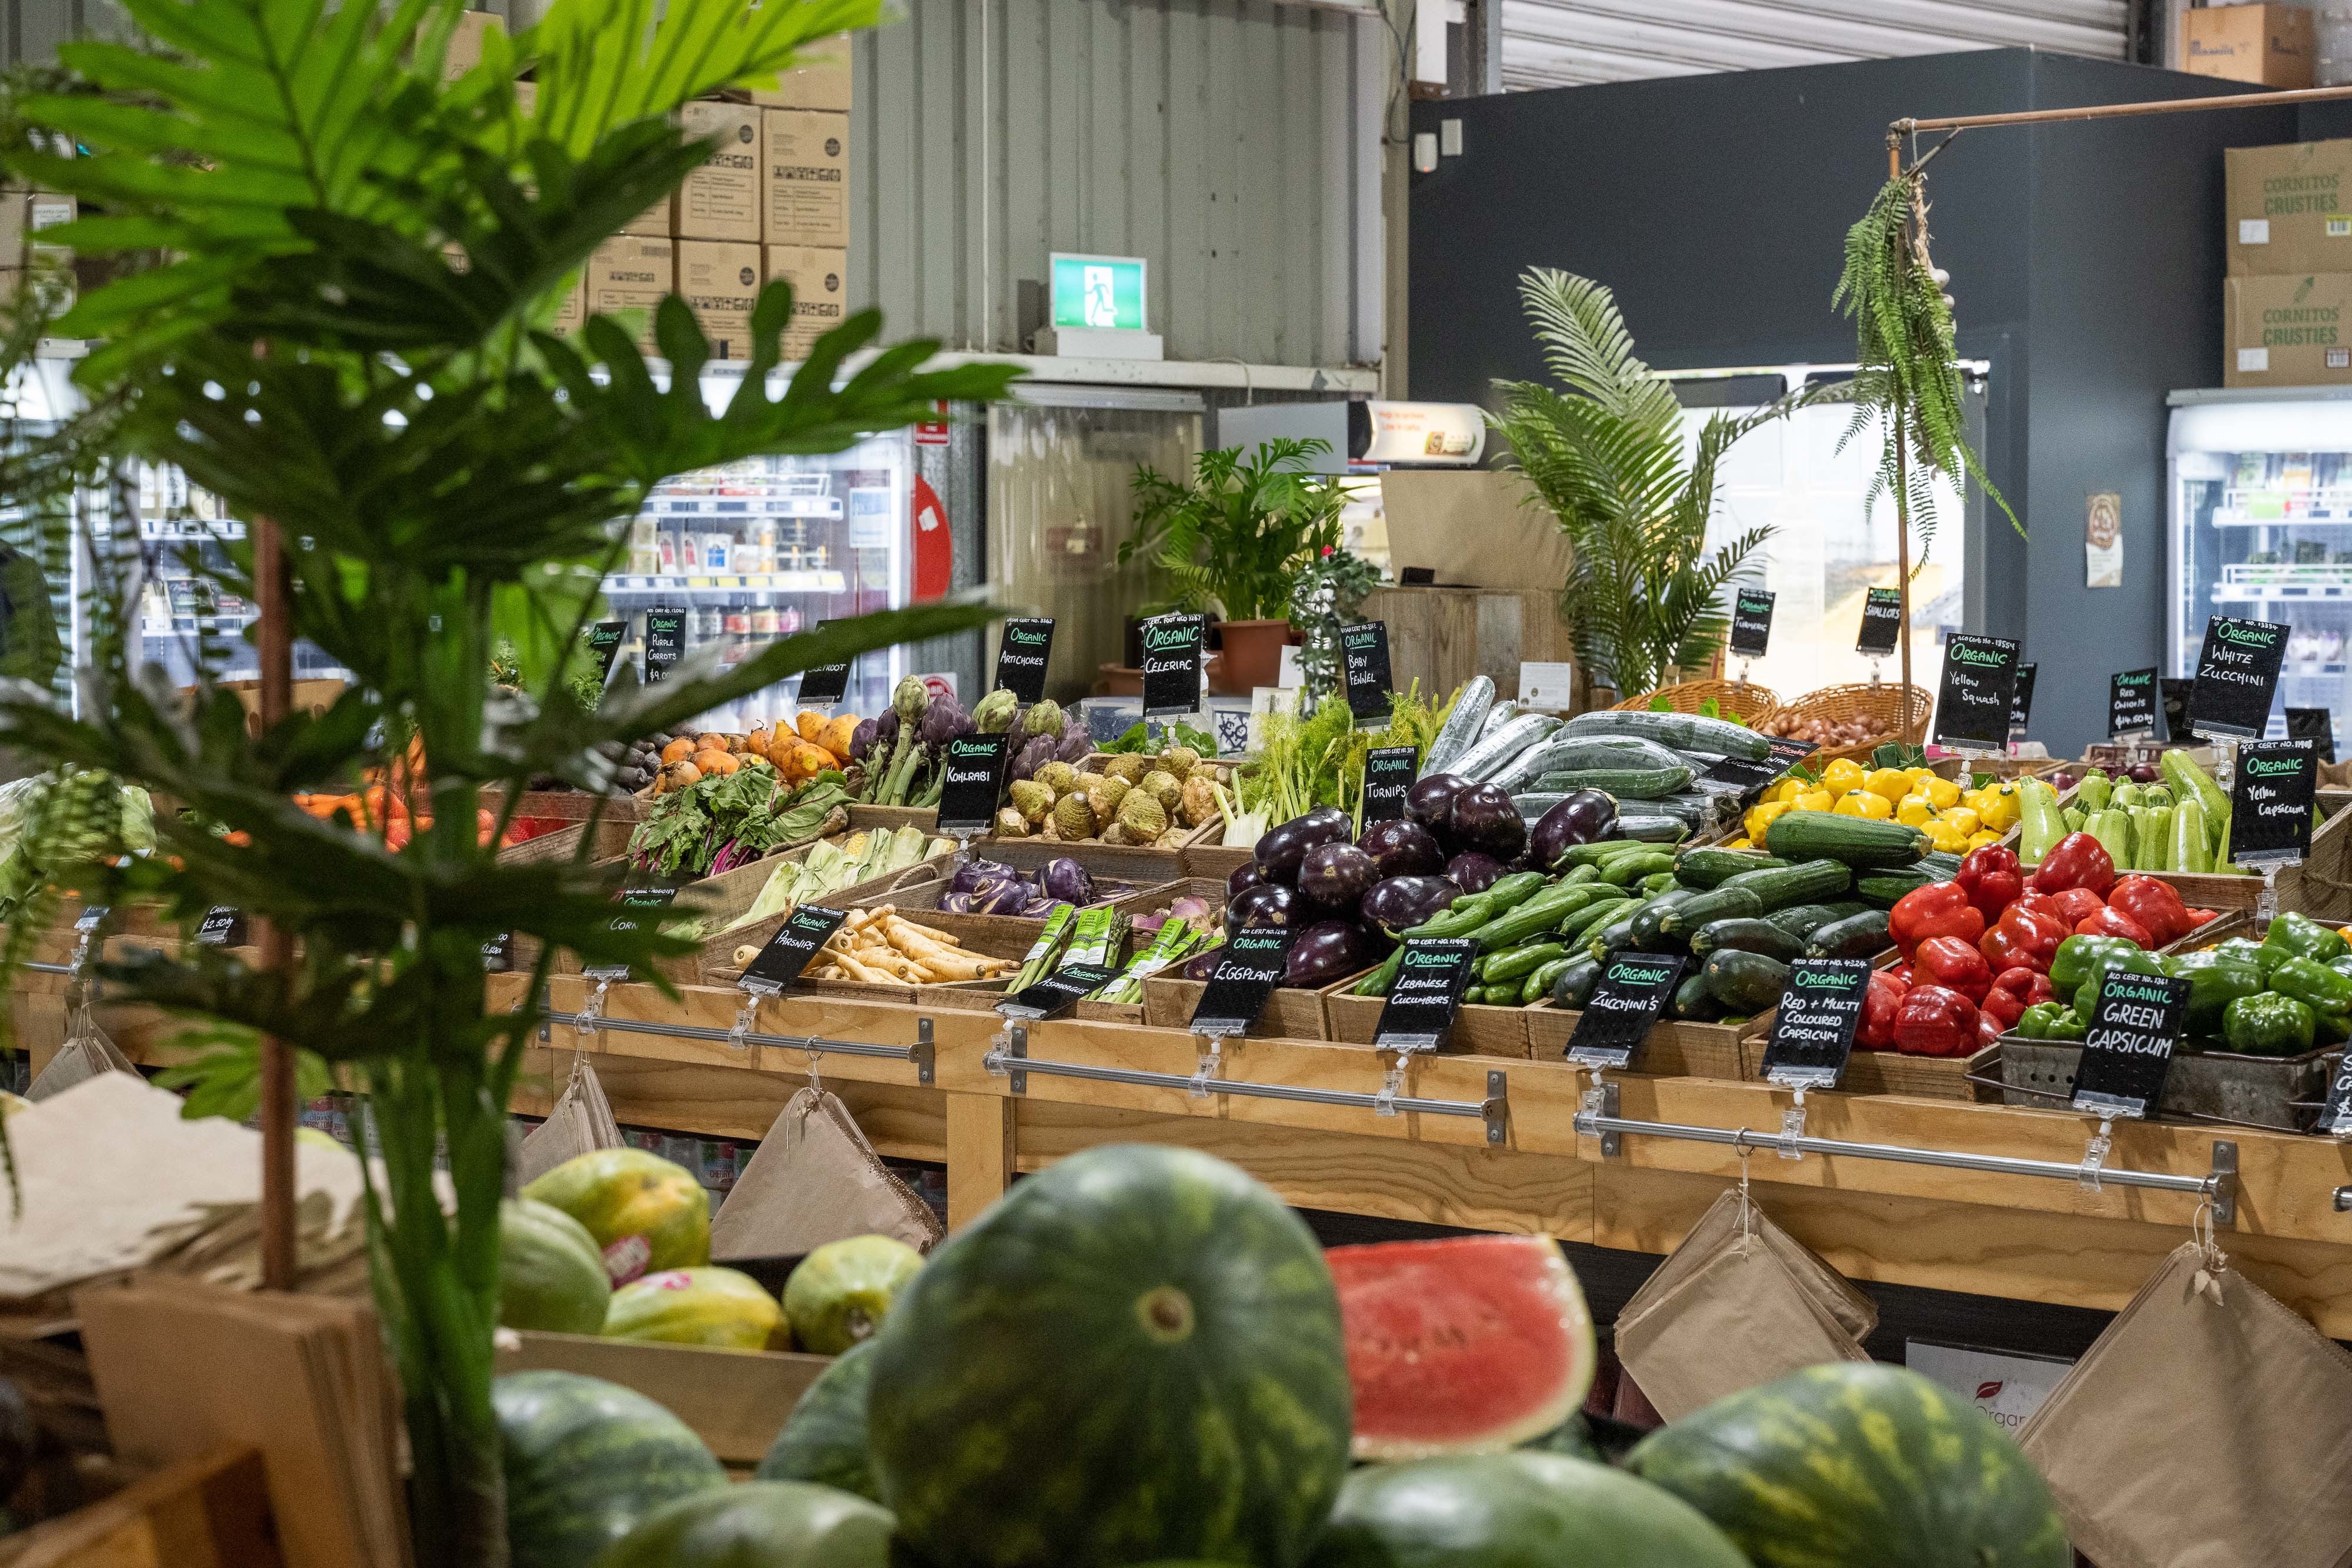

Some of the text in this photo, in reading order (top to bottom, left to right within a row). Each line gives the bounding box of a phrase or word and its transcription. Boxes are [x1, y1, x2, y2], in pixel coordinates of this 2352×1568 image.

[2263, 174, 2340, 193] CORNITOS
[2264, 193, 2340, 216] CRUSTIES
[2263, 307, 2339, 325] CORNITOS
[2263, 326, 2338, 347] CRUSTIES
[651, 618, 677, 629] ORGANIC
[652, 634, 674, 646] PURPLE
[1010, 627, 1047, 642] ORGANIC
[1146, 626, 1199, 648] ORGANIC
[1345, 633, 1377, 647] ORGANIC
[2218, 622, 2277, 644] ORGANIC
[648, 649, 677, 660] CARROTS
[1000, 650, 1044, 666] ARTICHOKES
[1348, 654, 1367, 668] BABY
[1950, 643, 2008, 664] ORGANIC
[2212, 644, 2254, 664] WHITE
[1145, 657, 1192, 673] CELERIAC
[1349, 670, 1376, 686] FENNEL
[1949, 671, 1979, 687] Yellow
[2200, 664, 2264, 686] ZUCCHINI
[1962, 688, 1999, 706] Squash
[951, 740, 997, 754] ORGANIC
[1371, 759, 1410, 772] ORGANIC
[2247, 757, 2303, 774] ORGANIC
[947, 766, 990, 783] KOHLRABI
[1366, 782, 1406, 798] TURNIPS
[791, 912, 830, 928] ORGANIC
[775, 930, 815, 950] PARSNIPS
[1234, 938, 1281, 950] ORGANIC
[1405, 950, 1462, 965] ORGANIC
[1063, 967, 1108, 980] ORGANIC
[1214, 961, 1279, 982] EGGPLANT
[1608, 964, 1670, 982] ORGANIC
[1795, 970, 1858, 986] ORGANIC
[2122, 973, 2141, 981] CERT
[1037, 978, 1089, 994] ASPARAGUS
[1395, 974, 1450, 989] LEBANESE
[1391, 993, 1450, 1005] CUCUMBERS
[1590, 991, 1659, 1011] ZUCCHINI'S
[2104, 982, 2173, 1004] ORGANIC
[1780, 991, 1806, 1010] RED
[1823, 997, 1860, 1012] MULTI
[1785, 1011, 1842, 1027] COLOURED
[2103, 1002, 2165, 1029] GREEN
[1778, 1025, 1838, 1042] CAPSICUM
[2086, 1028, 2173, 1059] CAPSICUM
